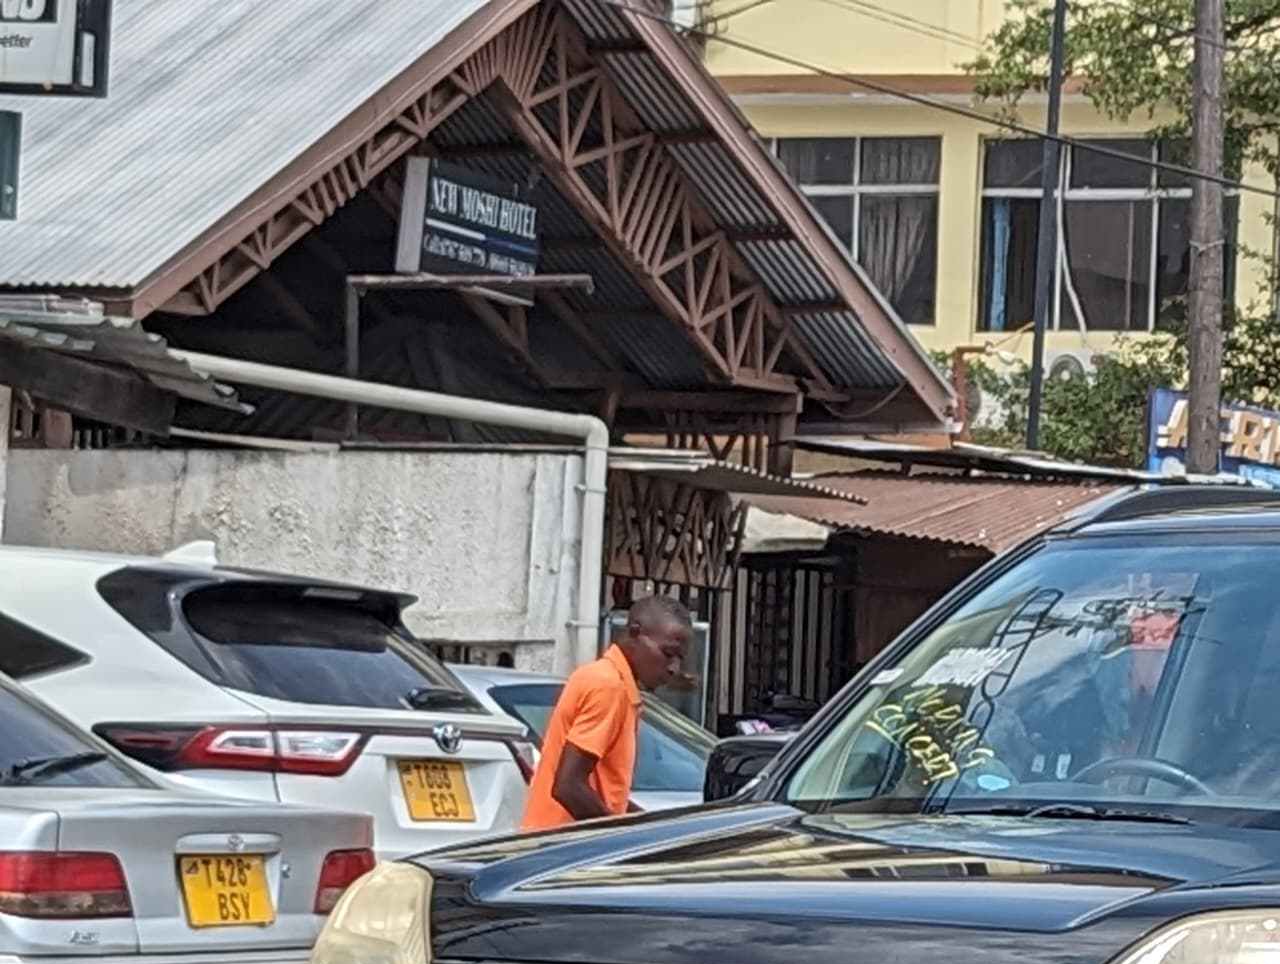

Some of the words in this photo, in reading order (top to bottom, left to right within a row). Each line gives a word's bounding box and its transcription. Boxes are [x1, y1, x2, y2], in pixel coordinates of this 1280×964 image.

[499, 198, 537, 240] HOTEL
[429, 792, 459, 818] ECJ
[218, 893, 250, 920] BSY
